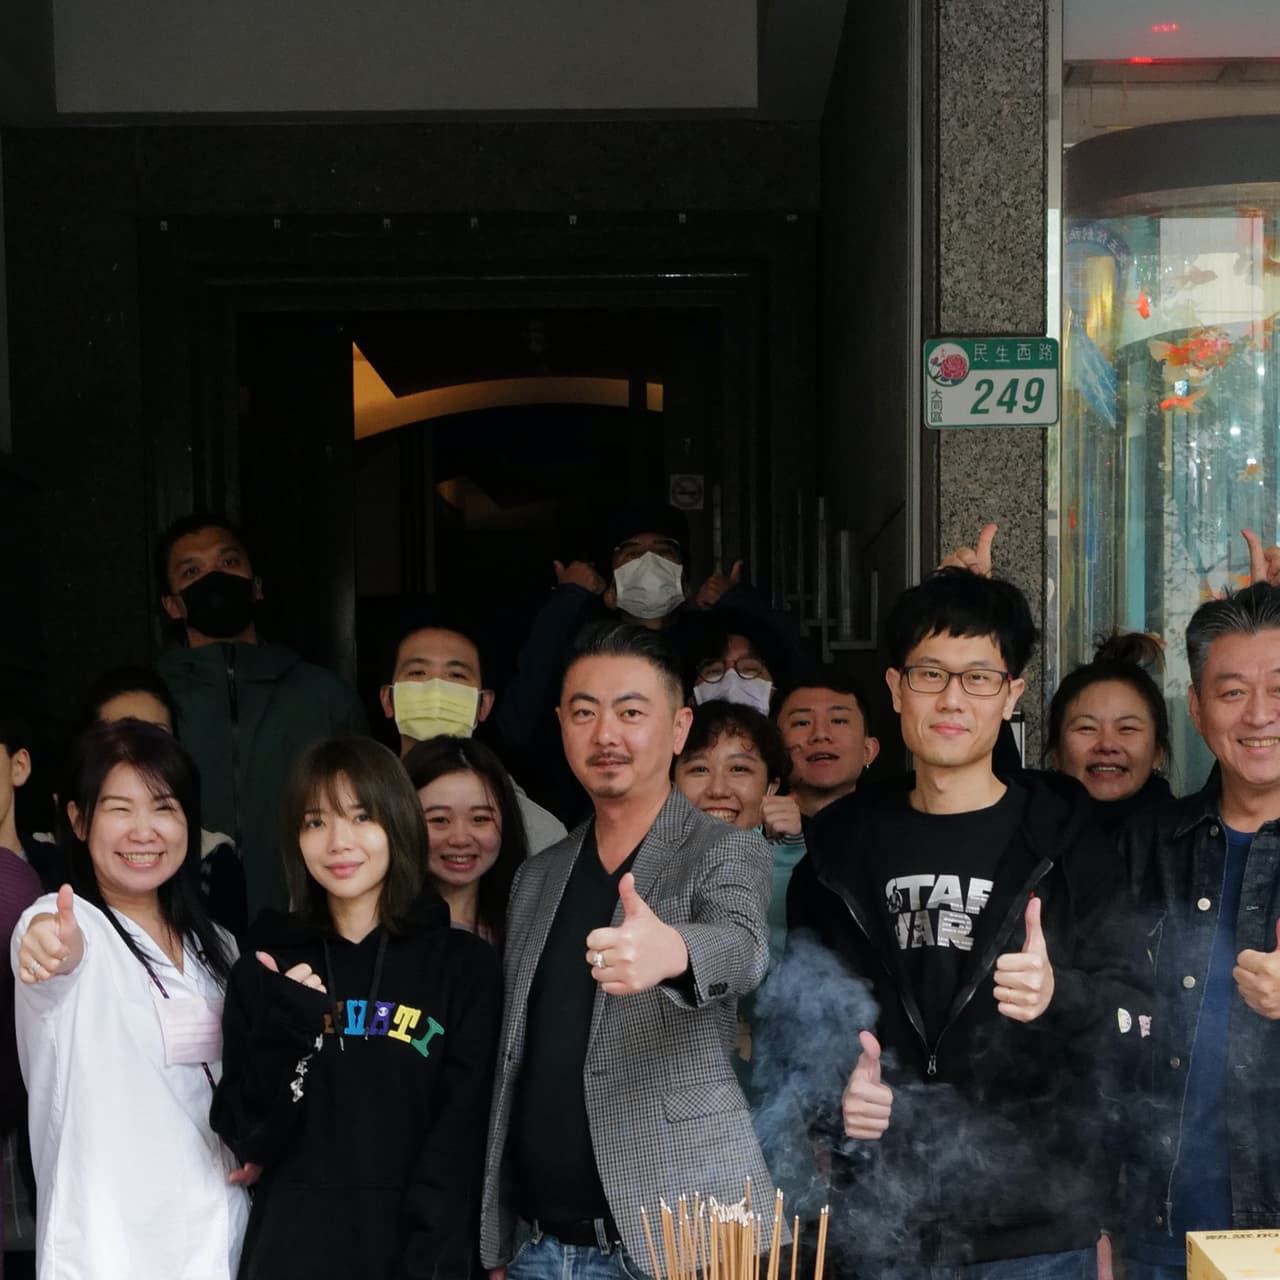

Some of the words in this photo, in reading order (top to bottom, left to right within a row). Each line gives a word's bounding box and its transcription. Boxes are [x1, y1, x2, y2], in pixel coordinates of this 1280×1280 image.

[973, 342, 1053, 363] 民生西路
[970, 377, 1045, 415] 249
